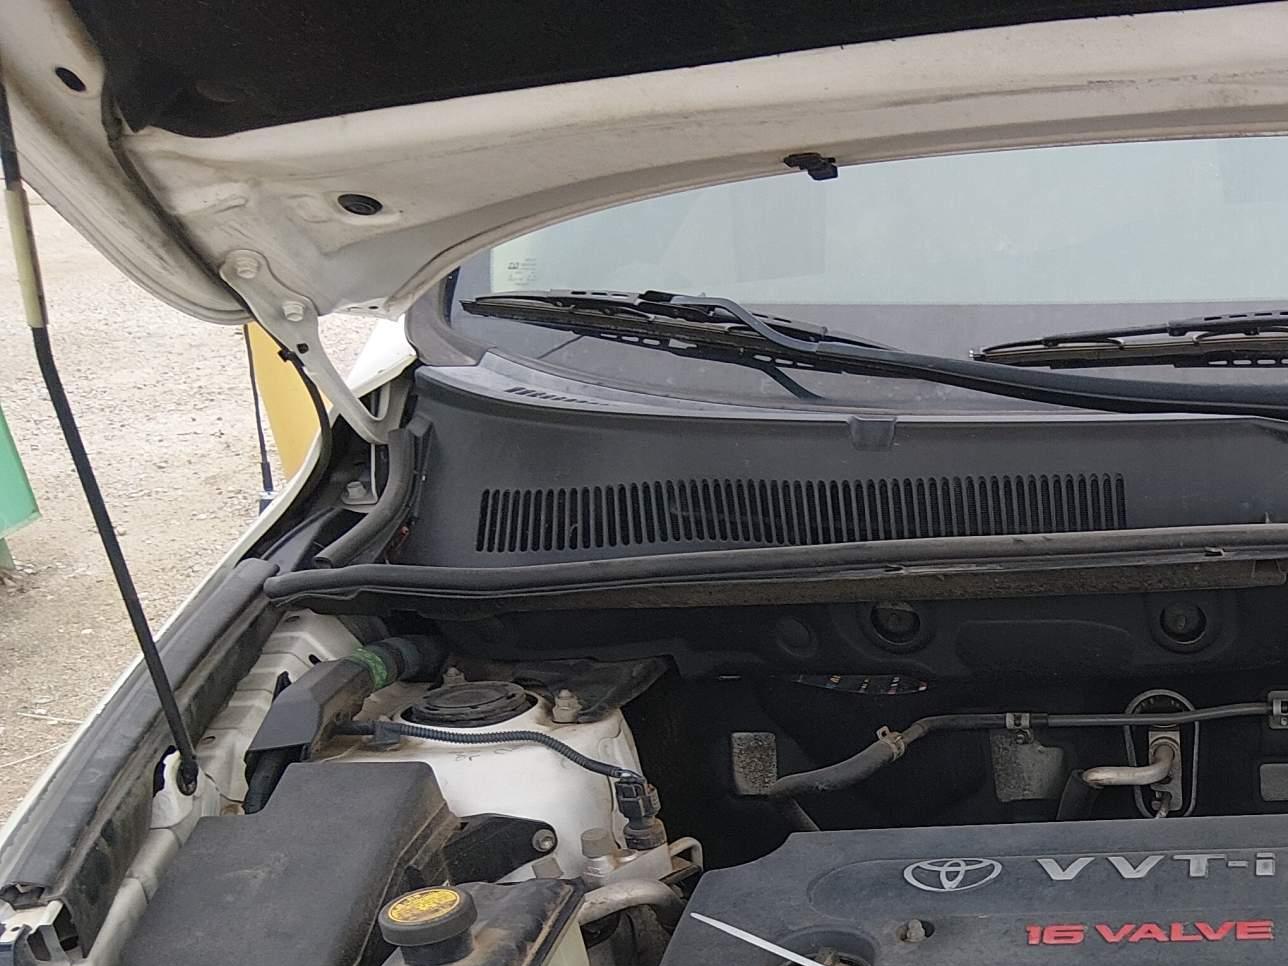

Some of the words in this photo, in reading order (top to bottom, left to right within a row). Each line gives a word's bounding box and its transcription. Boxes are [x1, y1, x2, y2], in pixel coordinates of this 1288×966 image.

[1036, 852, 1276, 881] VVT-i
[1026, 923, 1088, 945] 16
[1095, 919, 1274, 943] VALVE
